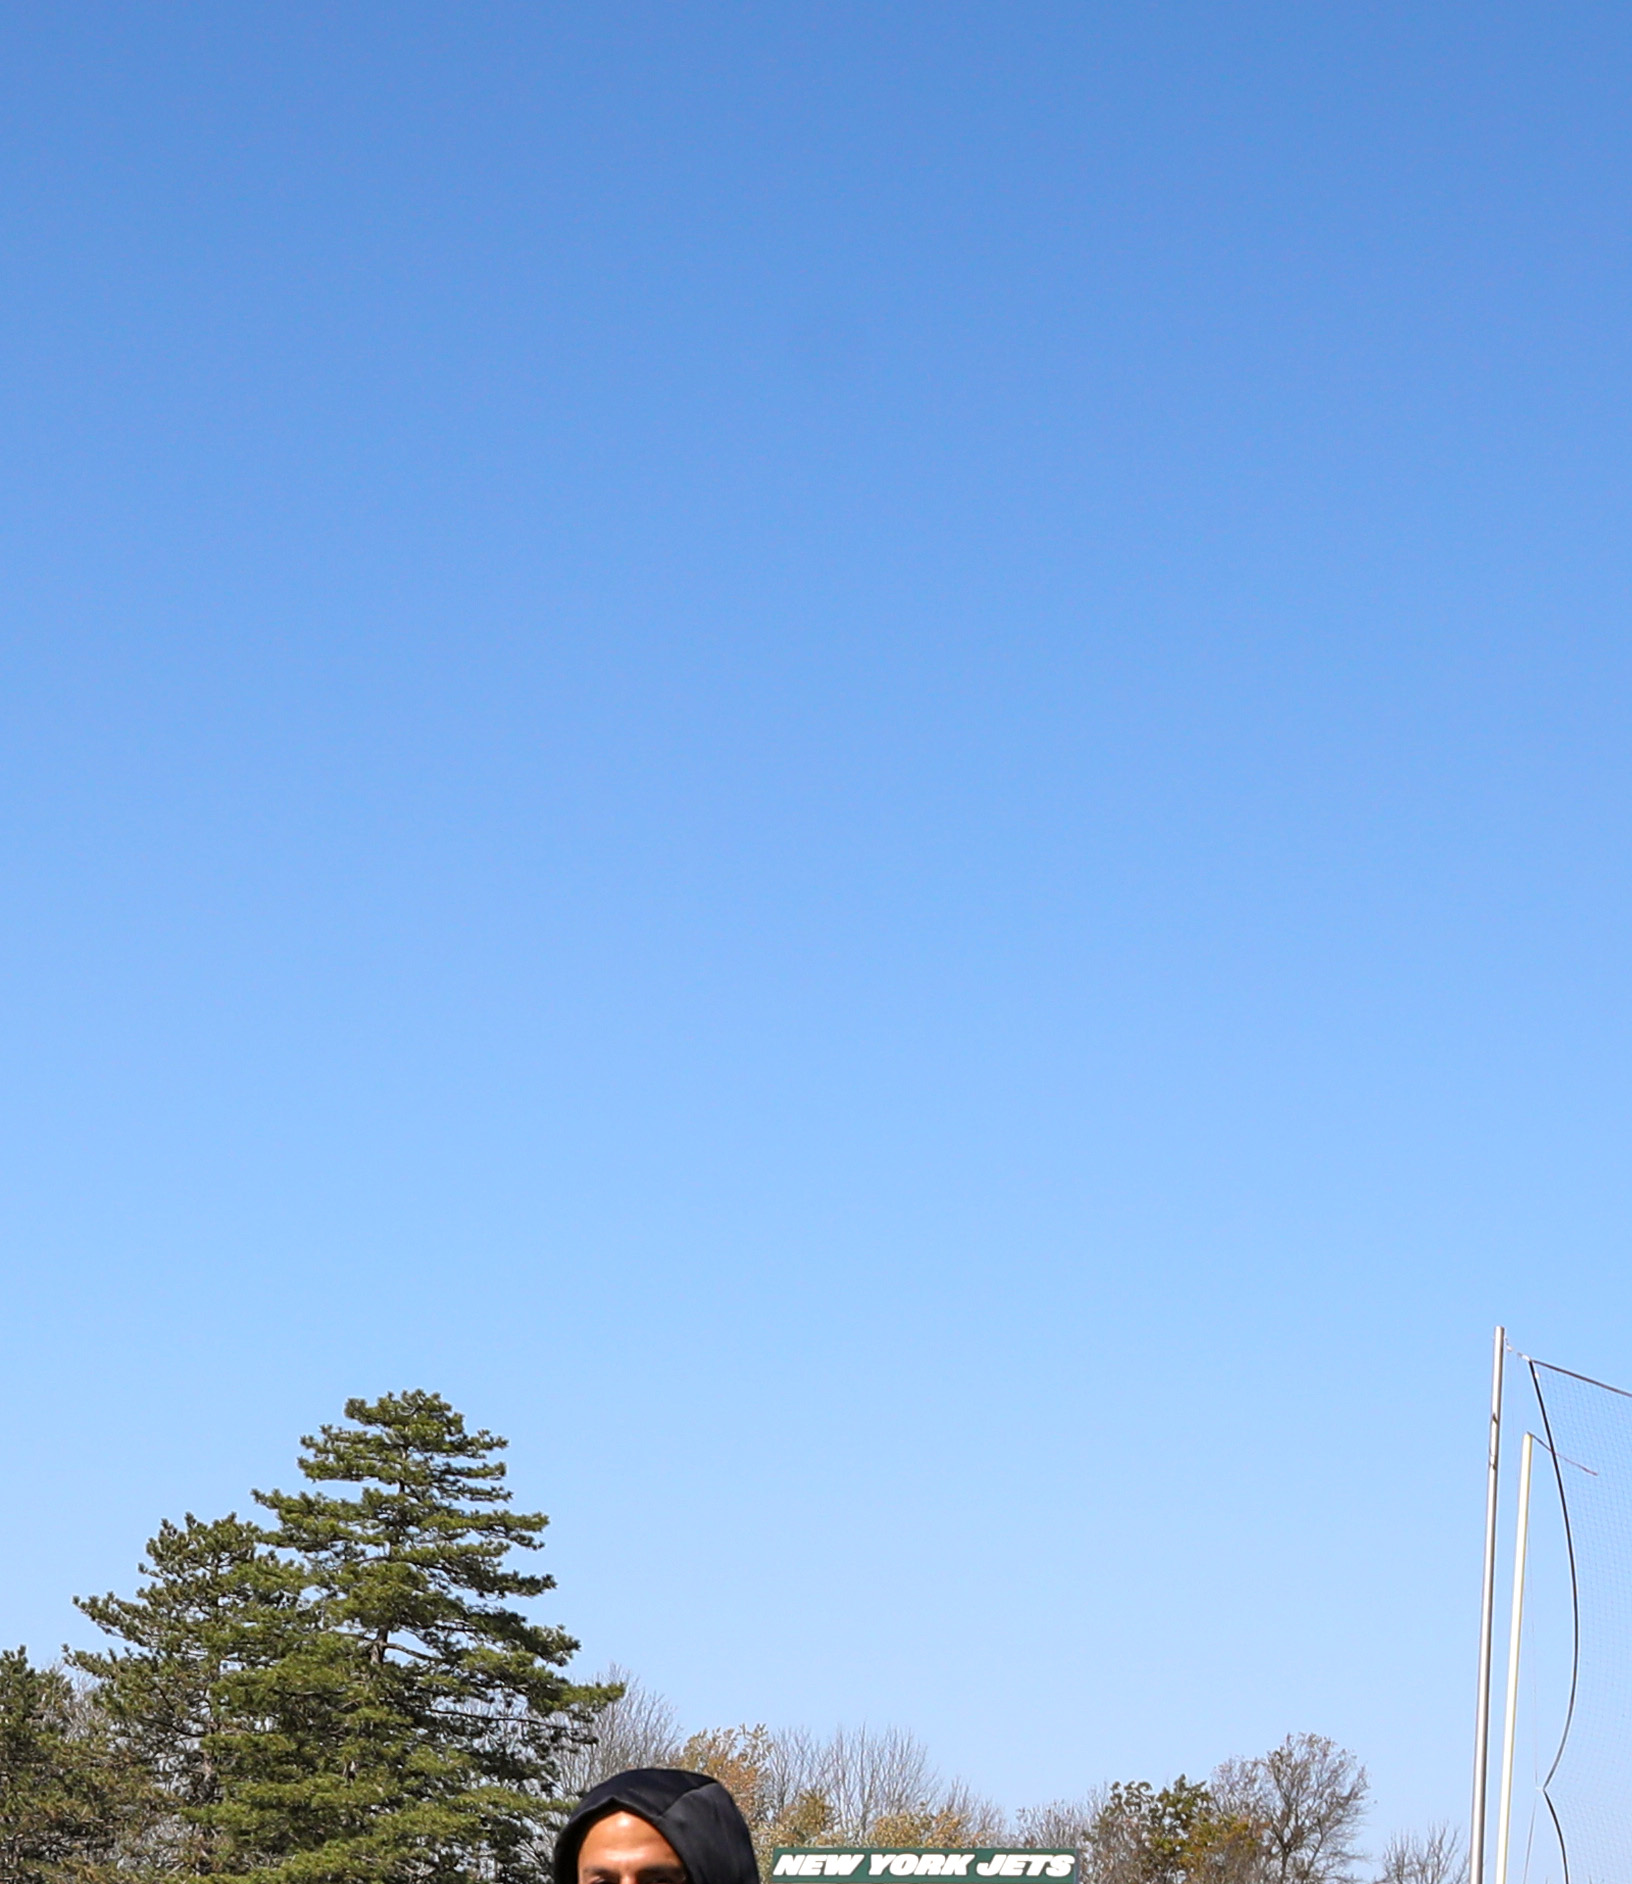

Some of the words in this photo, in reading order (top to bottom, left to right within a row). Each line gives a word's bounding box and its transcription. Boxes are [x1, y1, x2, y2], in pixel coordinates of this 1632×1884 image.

[773, 1854, 864, 1876] NEW
[867, 1854, 976, 1876] YORK
[976, 1854, 1076, 1877] JETS
